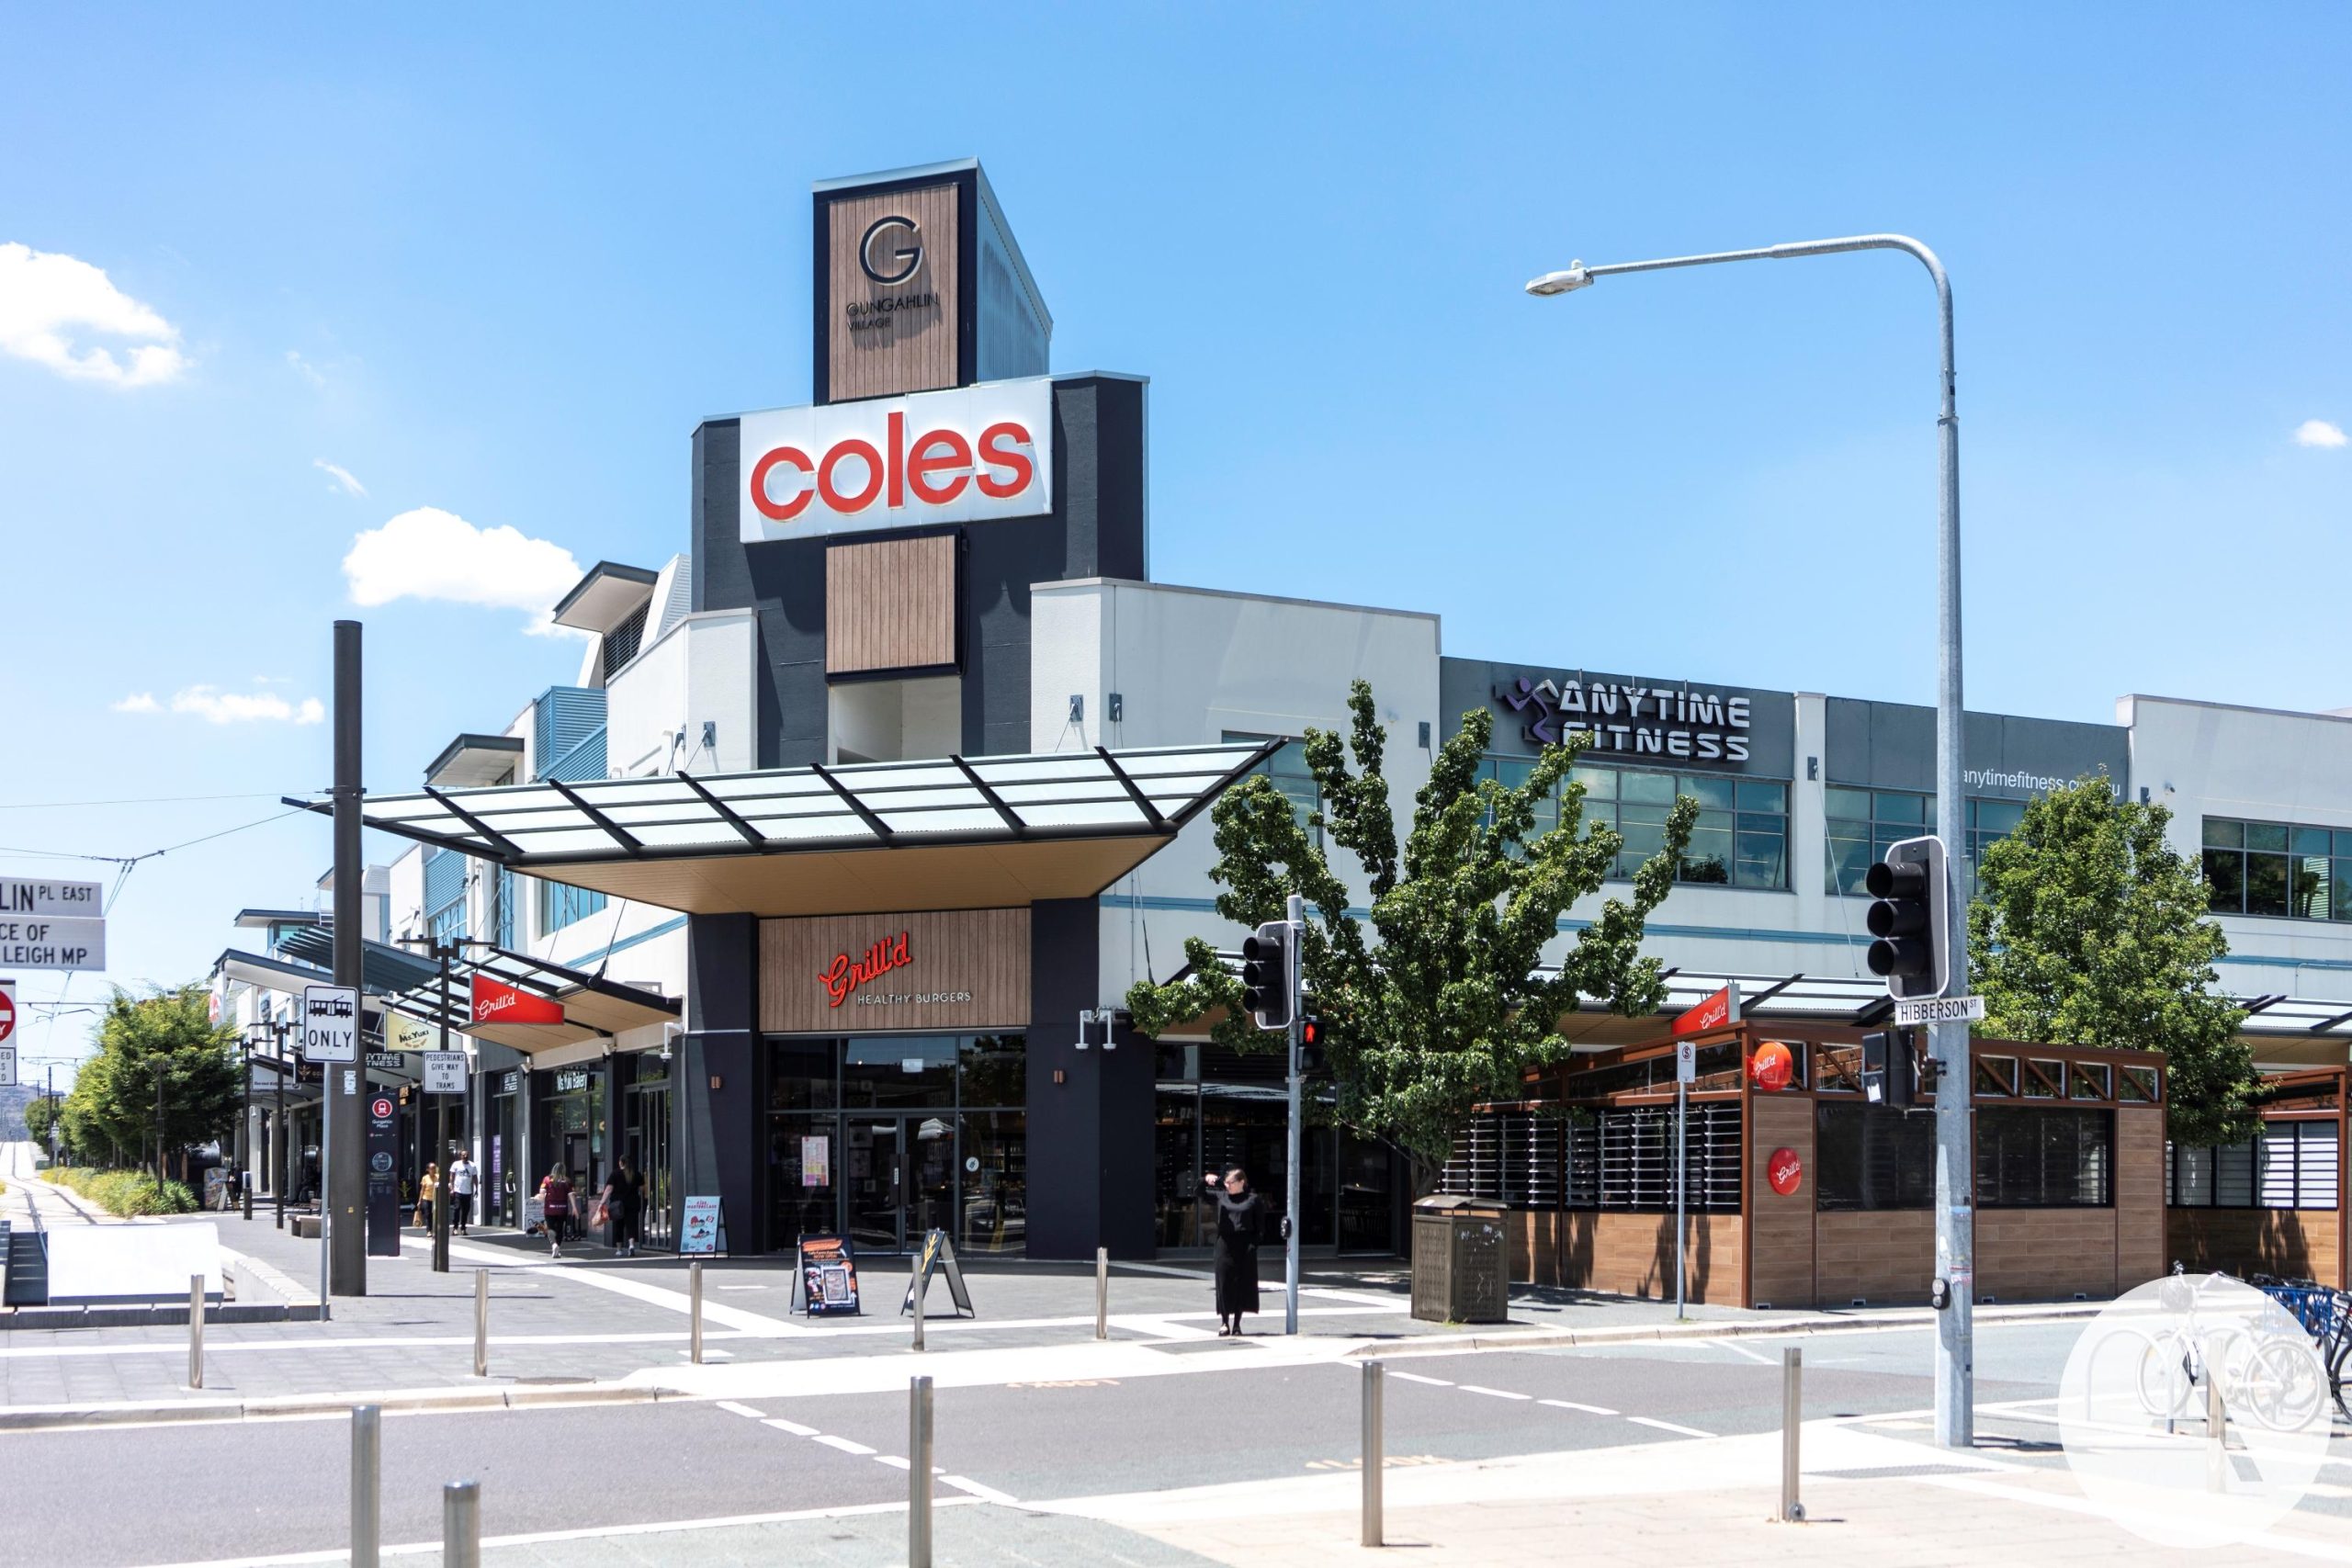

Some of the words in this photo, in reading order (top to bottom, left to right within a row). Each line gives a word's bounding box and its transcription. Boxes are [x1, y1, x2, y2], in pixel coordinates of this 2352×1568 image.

[859, 216, 923, 287] G
[846, 292, 939, 317] GUNGAHLIN
[848, 317, 891, 332] VILLAGE
[751, 412, 1034, 522] coles
[1559, 680, 1750, 728] ANYTIME
[1563, 721, 1750, 761] FITNESS
[39, 886, 55, 900] PL
[62, 886, 93, 902] EAST
[27, 924, 50, 942] OF
[4, 946, 55, 964] LEIGH
[62, 947, 87, 964] MP
[818, 931, 913, 1009] Grill'd
[475, 992, 516, 1021] Grill'd
[857, 993, 911, 1005] HEALTHY
[916, 992, 972, 1003] BURGERS
[1901, 1000, 1968, 1021] HIBBERSON
[1970, 999, 1977, 1009] ST
[1700, 1002, 1726, 1030] Grill'd
[309, 1030, 352, 1048] ONLY
[426, 1054, 465, 1062] PEDESTRIANS
